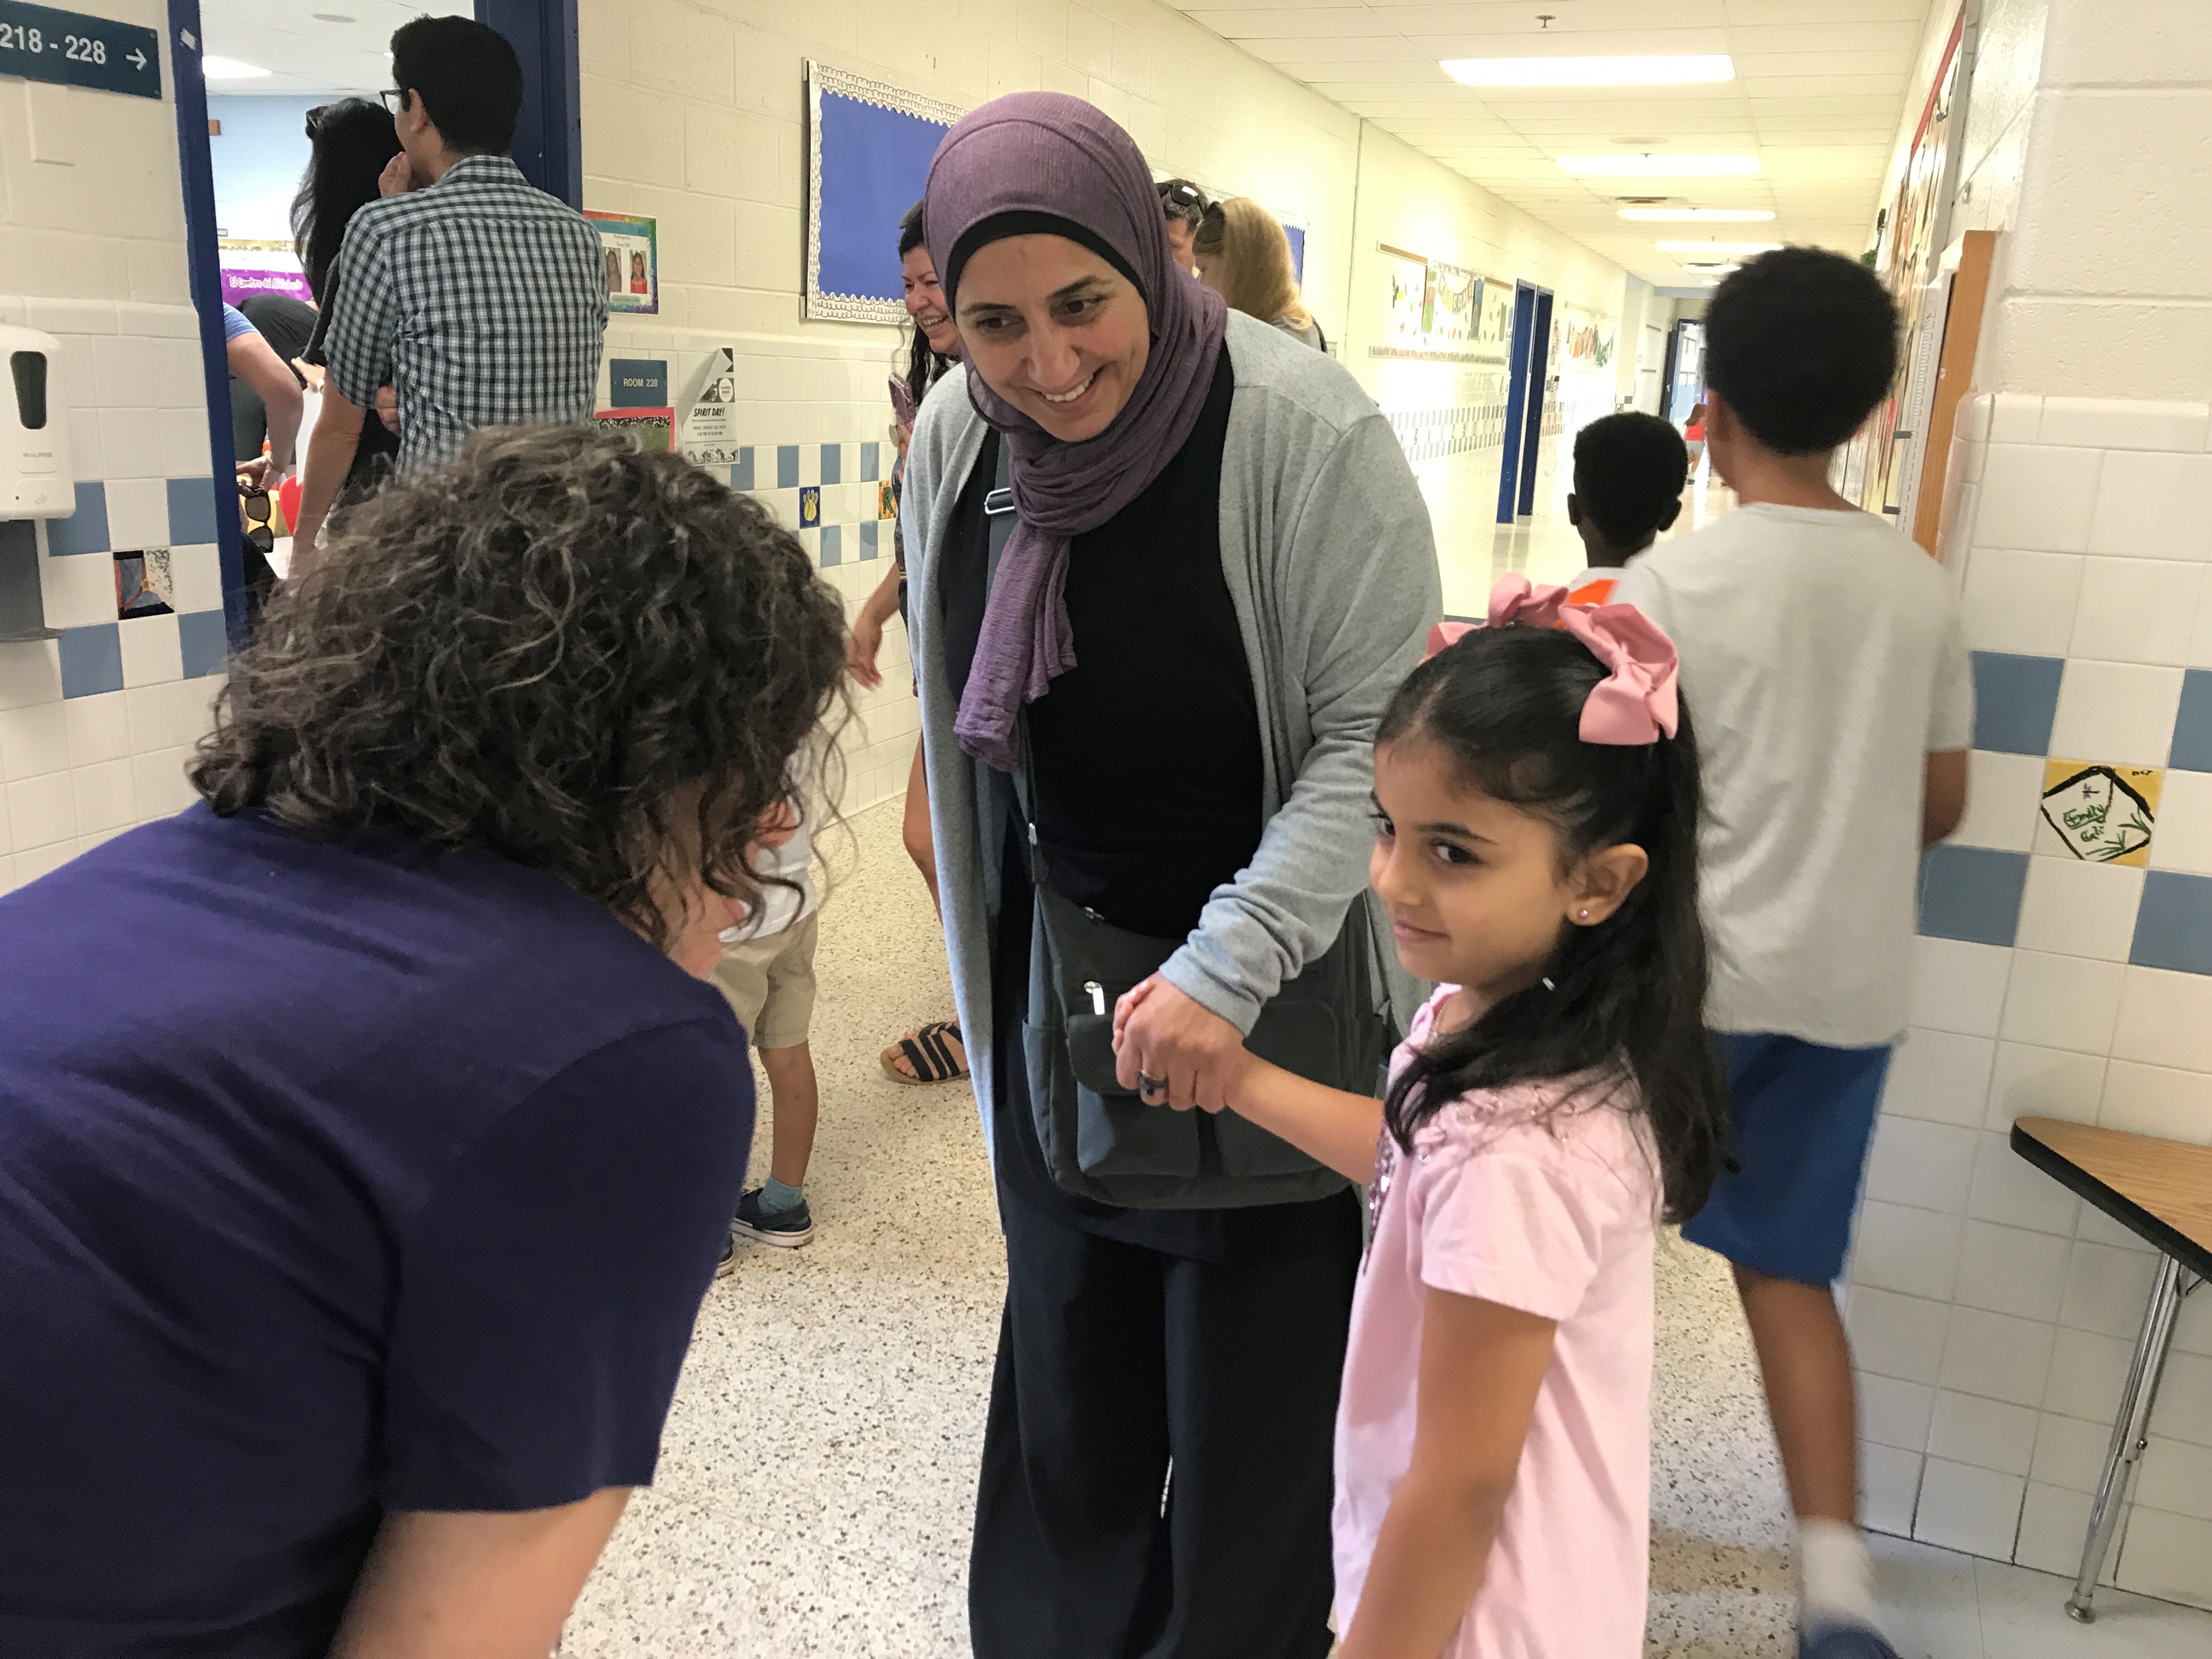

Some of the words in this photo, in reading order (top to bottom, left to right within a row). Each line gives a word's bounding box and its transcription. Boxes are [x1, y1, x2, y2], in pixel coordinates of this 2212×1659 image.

[0, 22, 43, 53] 218
[64, 35, 106, 65] 228
[623, 378, 644, 387] ROOM
[646, 378, 658, 387] 228
[693, 408, 711, 417] SPIRIT
[712, 407, 725, 416] DAY!
